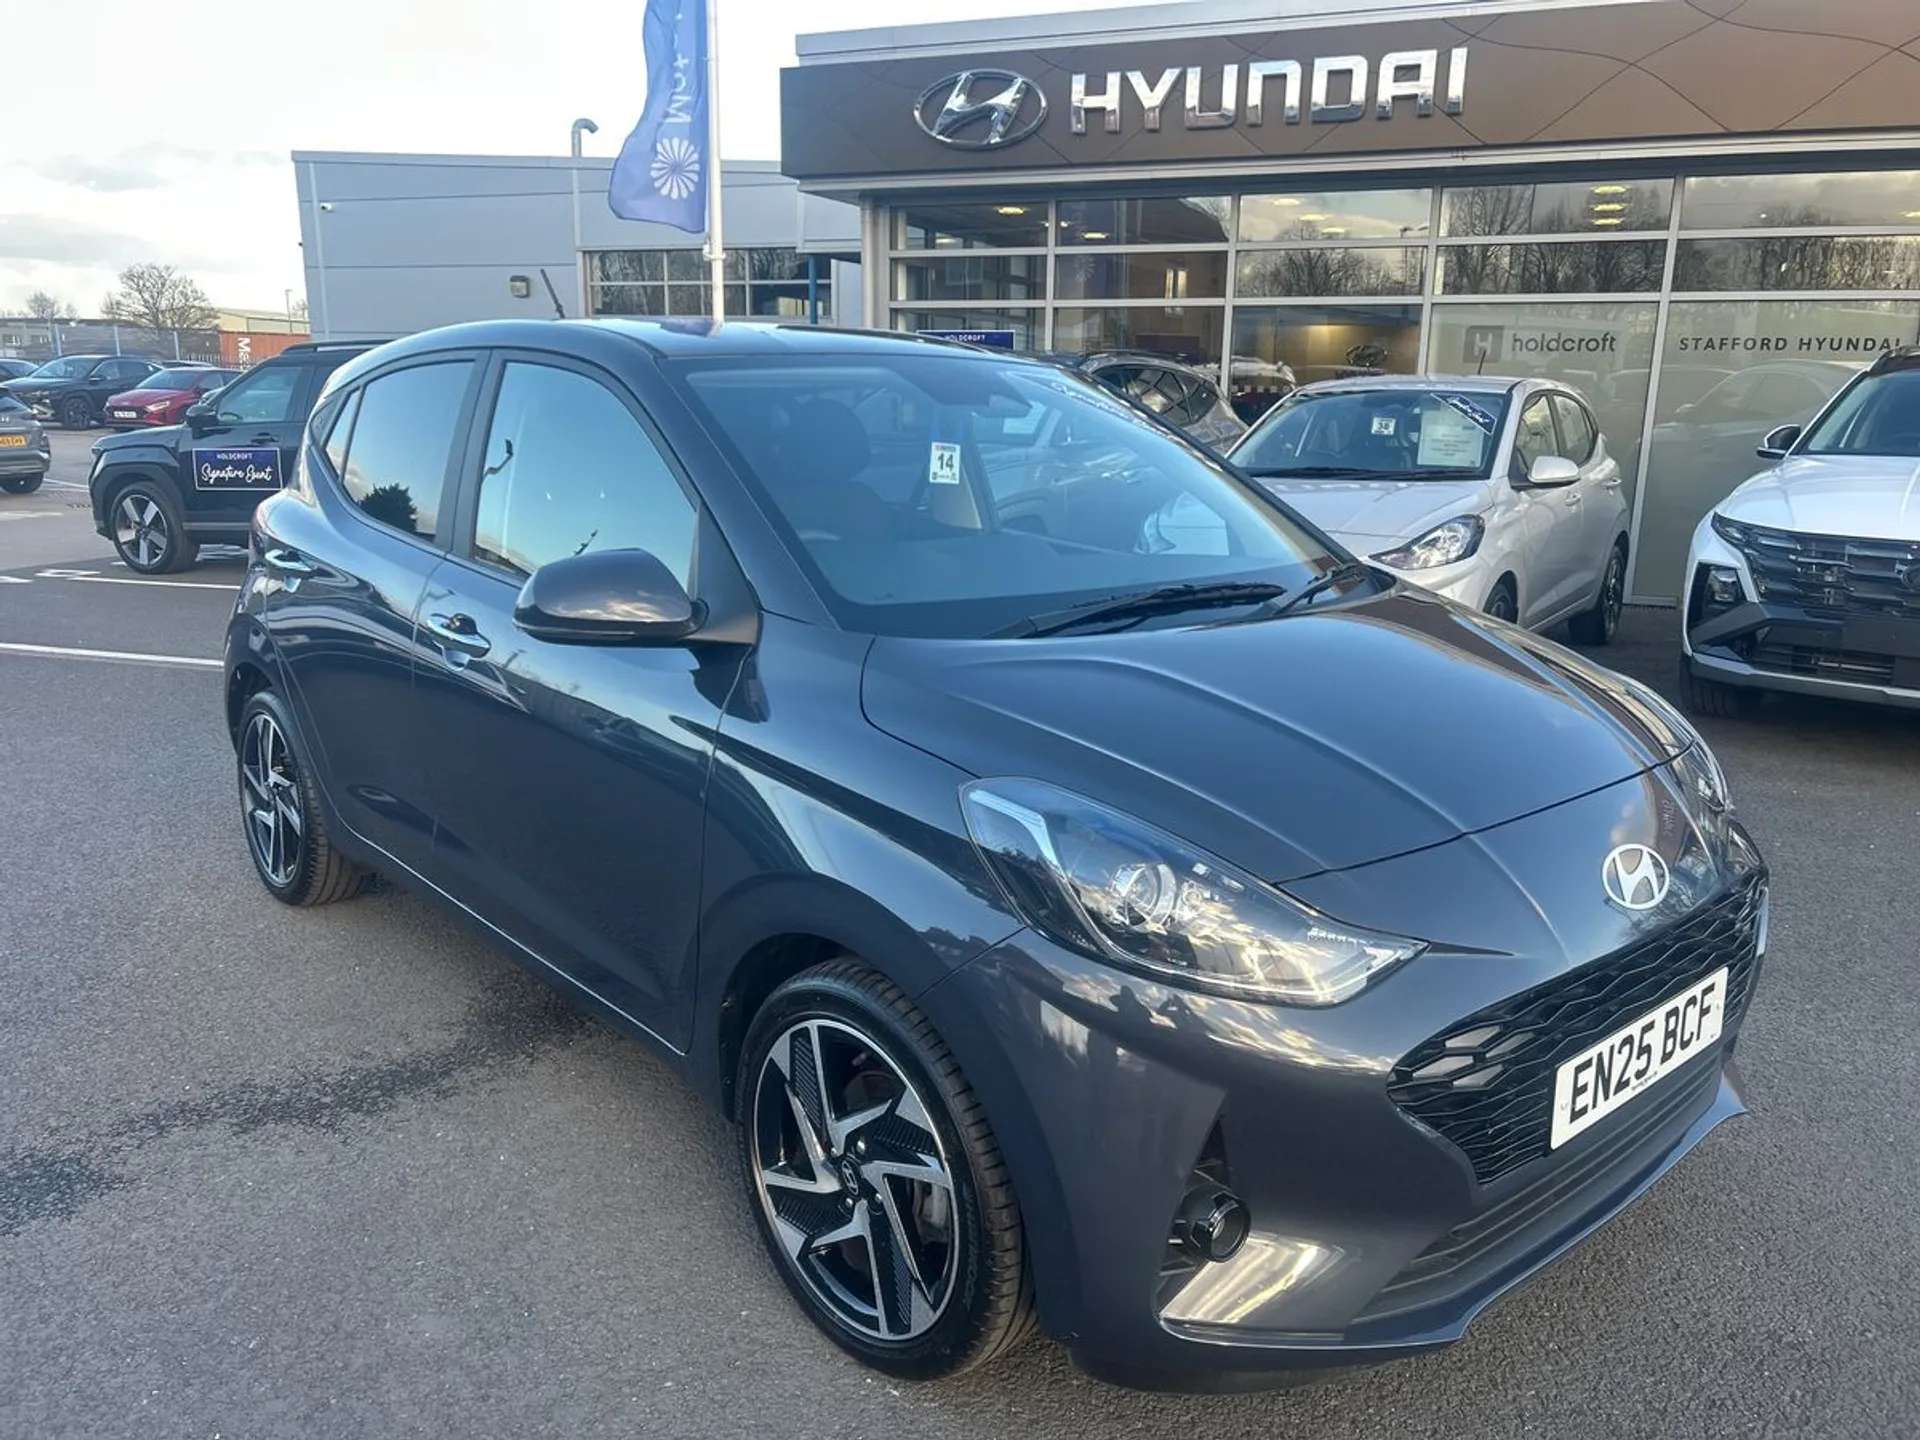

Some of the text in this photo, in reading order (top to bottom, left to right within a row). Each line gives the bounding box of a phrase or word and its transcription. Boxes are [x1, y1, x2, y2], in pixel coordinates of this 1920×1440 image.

[1070, 47, 1468, 135] HYUNDAI
[1512, 331, 1616, 352] holdcroft
[1679, 337, 1901, 351] STAFFORD HYUNDAI
[938, 452, 954, 471] 14
[1570, 982, 1715, 1124] EN25 BCF
